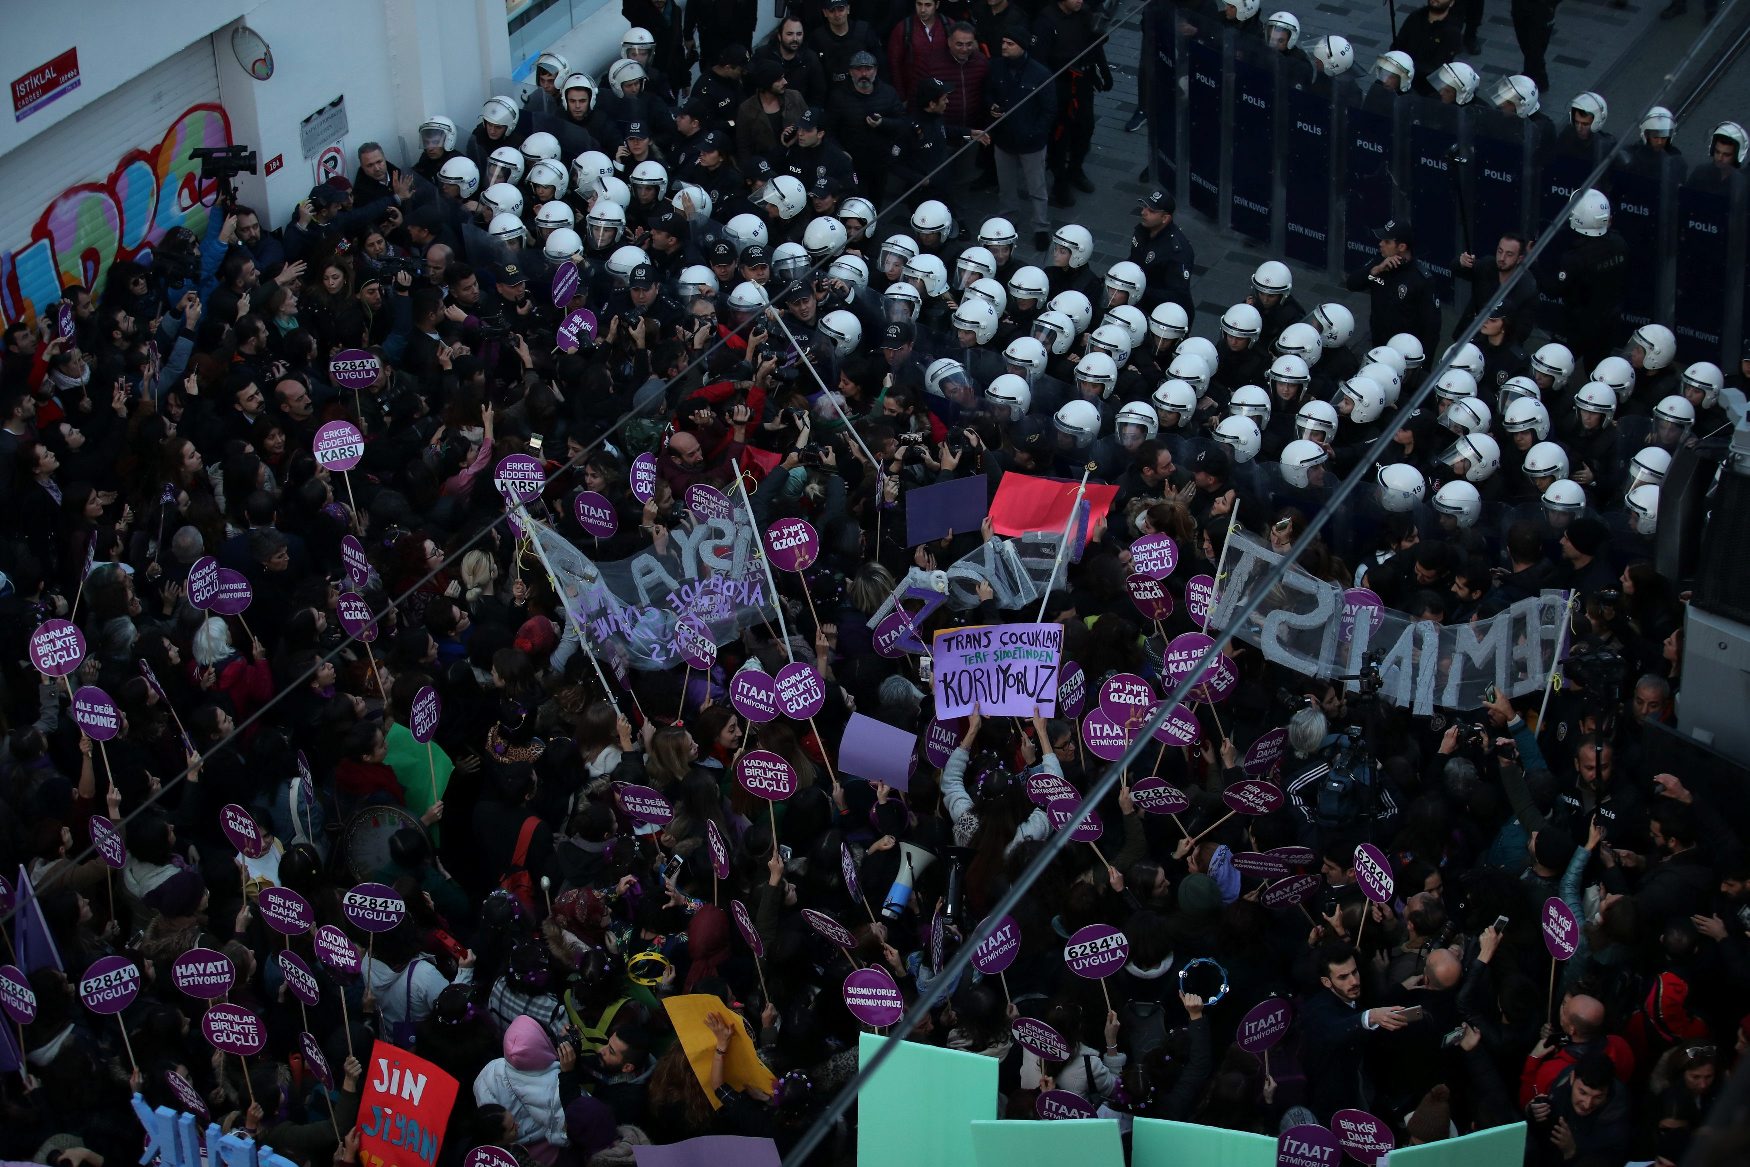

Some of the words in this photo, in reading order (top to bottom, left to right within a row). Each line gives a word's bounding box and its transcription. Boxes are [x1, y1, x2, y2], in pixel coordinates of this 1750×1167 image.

[1242, 93, 1265, 108] POLİS
[1296, 120, 1322, 135] POLİS
[1356, 139, 1383, 153] POLİS
[269, 159, 280, 171] 184
[1420, 157, 1448, 171] POLİS
[1484, 168, 1512, 183] POLİS
[1619, 202, 1648, 216] POLİS
[1687, 219, 1718, 234] POLİS
[333, 360, 376, 372] 6284'Ü
[336, 370, 377, 380] UYGULA
[323, 426, 352, 440] ERKEK
[506, 462, 535, 471] ERKEK
[692, 487, 729, 508] KADINLAR
[692, 494, 729, 515] BİRLİKTE
[579, 500, 611, 521] İTAAT
[580, 515, 614, 529] ETMİYORUZ
[768, 528, 781, 541] jin
[781, 523, 805, 538] jiyan
[772, 529, 810, 551] azadi
[1131, 539, 1170, 554] KADINLAR
[1133, 547, 1171, 562] BİRLİKTE
[190, 560, 217, 581] KADINLAR
[1135, 556, 1173, 573] GÜÇLÜ
[192, 570, 218, 591] BİRLİKTE
[194, 580, 219, 603] GÜÇLÜ
[1133, 585, 1164, 600] azadi
[34, 625, 76, 646] KADINLAR
[943, 630, 993, 652] TRANS
[37, 635, 78, 656] BİRLİKTE
[40, 645, 81, 668] GÜÇLÜ
[961, 650, 988, 665] TERF
[1168, 650, 1188, 662] AİLE
[776, 666, 813, 691] KADINLAR
[1109, 679, 1123, 693] jin
[1123, 680, 1149, 695] jiyan
[738, 678, 775, 704] İTAAT
[780, 675, 817, 701] BİRLİKTE
[413, 691, 436, 715] KADINLAR
[735, 694, 775, 714] ETMİYORUZ
[786, 685, 822, 713] GÜÇLÜ
[1061, 685, 1085, 711] UYGULA
[1109, 691, 1149, 707] azadi
[75, 699, 92, 711] AİLE
[93, 703, 116, 717] DEĞİL
[414, 700, 437, 725] BİRLİKTE
[76, 711, 117, 729] KADINIZ
[416, 709, 437, 737] GÜÇLÜ
[1171, 717, 1196, 734] DEĞİL
[931, 722, 957, 746] İTAAT
[743, 759, 788, 771] KADINLAR
[744, 766, 789, 781] BİRLİKTE
[745, 777, 790, 793] GÜÇLÜ
[1030, 778, 1063, 789] KADIN
[624, 794, 643, 804] AİLE
[644, 797, 669, 808] DEĞİL
[626, 802, 672, 817] KADINIZ
[1140, 796, 1188, 808] UYGULA
[228, 820, 256, 840] azadi
[1355, 860, 1386, 900] UYGULA
[268, 893, 285, 906] BİR
[285, 899, 304, 913] KİŞİ
[270, 903, 298, 920] DAHA
[348, 894, 403, 913] 6284'Ü
[348, 907, 398, 923] UYGULA
[321, 929, 349, 949] KADIN
[1067, 935, 1123, 958] 6284'Ü
[979, 938, 1017, 967] ETMİYORUZ
[1072, 949, 1125, 970] UYGULA
[175, 959, 229, 977] HAYATI
[83, 967, 136, 993] 6284'Ü
[178, 973, 231, 987] İSTİYORUZ
[283, 970, 318, 1001] UYGULA
[88, 981, 137, 1006] UYGULA
[846, 986, 897, 997] SUSMUYORUZ
[846, 997, 902, 1008] KORKMUYORUZ
[208, 1011, 256, 1024] KADINLAR
[1245, 1008, 1285, 1036] İTAAT
[210, 1020, 258, 1034] BİRLİKTE
[1025, 1022, 1058, 1041] ERKEK
[1244, 1022, 1285, 1045] ETMİYORUZ
[212, 1031, 259, 1047] GÜÇLÜ
[373, 1057, 428, 1107] JİN
[1045, 1097, 1091, 1119] İTAAT
[361, 1105, 438, 1165] JİYAN
[1339, 1118, 1356, 1132] BİR
[1357, 1121, 1377, 1135] KİŞİ
[1347, 1131, 1376, 1144] DAHA
[475, 1148, 490, 1161] jin
[1282, 1135, 1335, 1161] İTAAT
